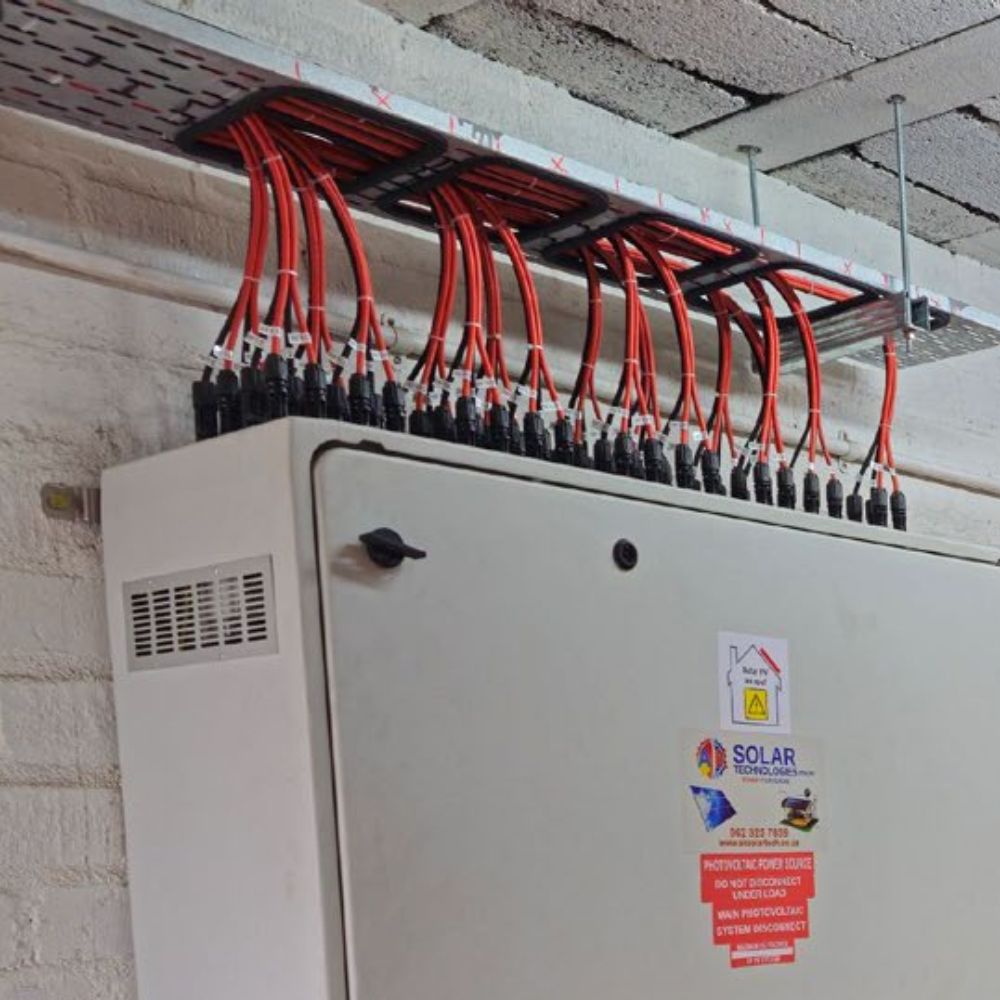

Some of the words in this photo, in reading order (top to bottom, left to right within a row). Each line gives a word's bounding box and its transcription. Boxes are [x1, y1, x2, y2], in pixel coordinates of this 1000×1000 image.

[733, 744, 795, 766] SOLAR
[733, 765, 797, 776] TECHNOLOGIES
[714, 879, 728, 888] DO
[749, 876, 801, 888] DISCONNECT
[733, 889, 761, 899] UNDER
[763, 888, 786, 898] LOAD
